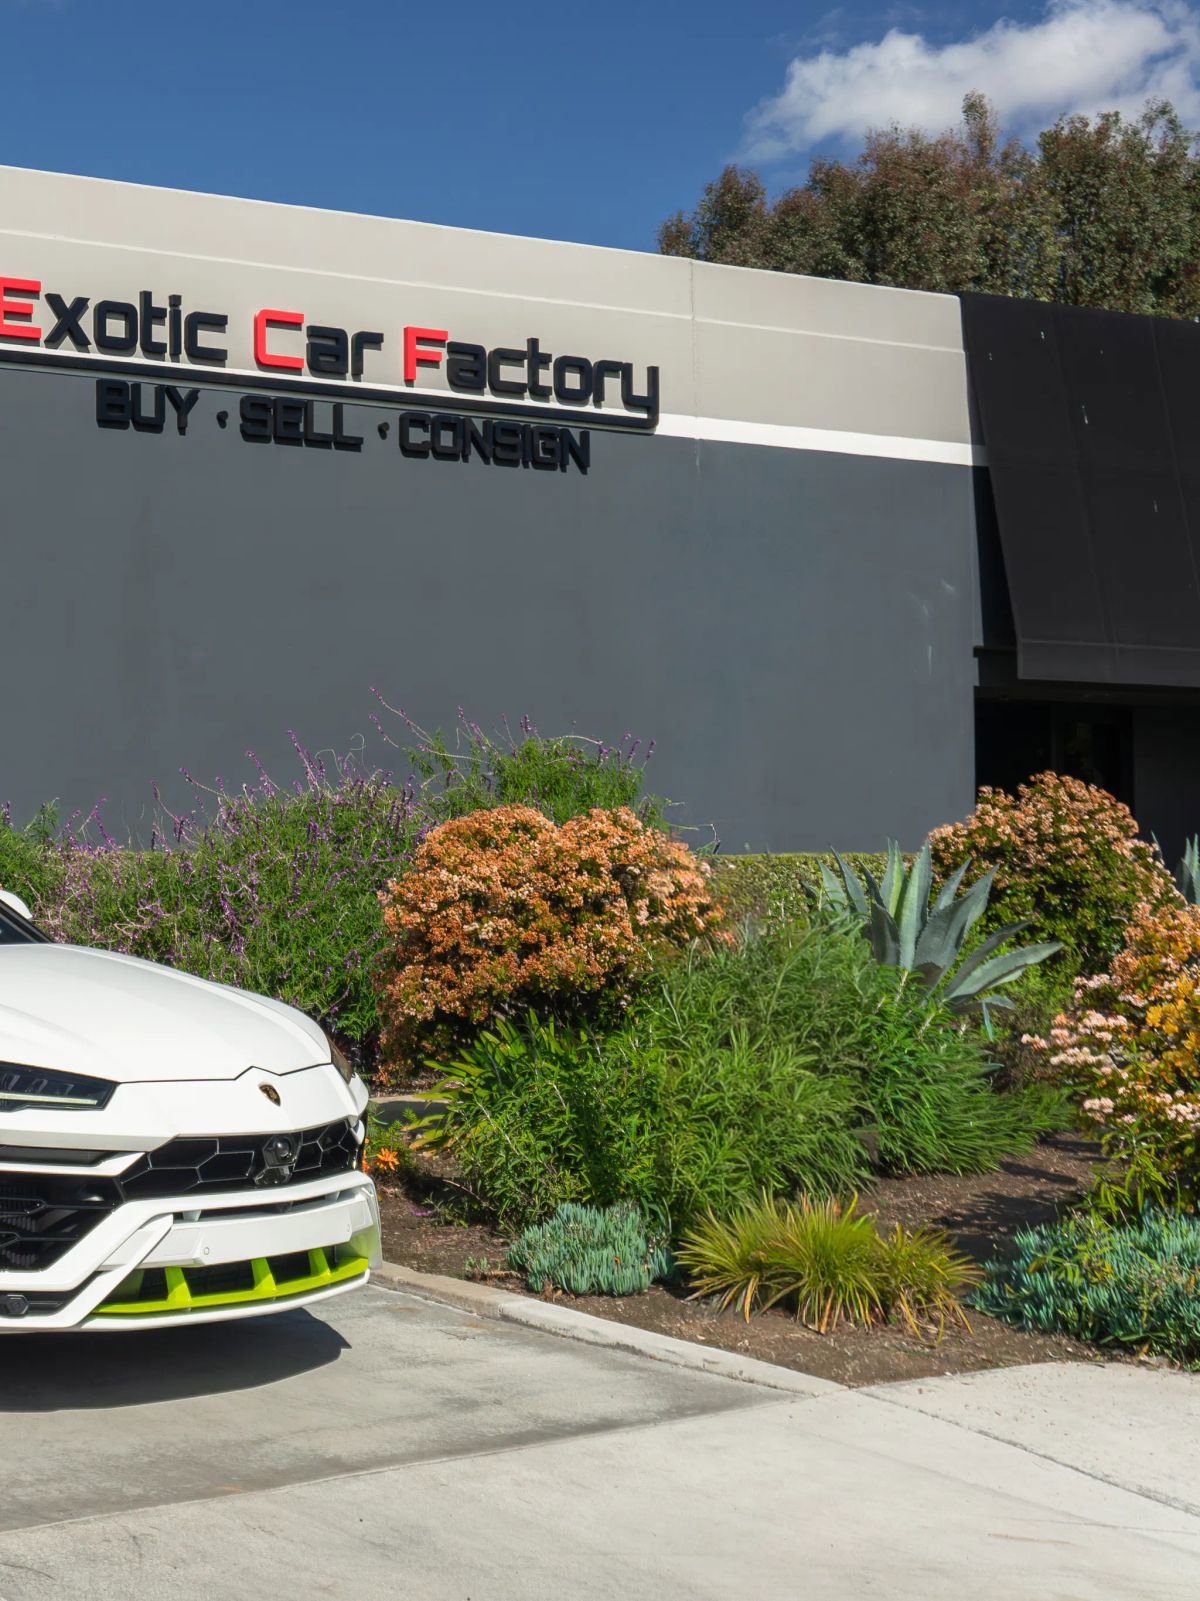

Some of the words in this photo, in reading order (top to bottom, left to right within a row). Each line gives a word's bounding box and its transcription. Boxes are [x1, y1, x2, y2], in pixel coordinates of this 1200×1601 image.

[253, 309, 384, 376] Car
[403, 326, 660, 430] Factory
[96, 379, 200, 434] BUY
[240, 395, 364, 451] SELL
[399, 412, 590, 474] CONSIGN
